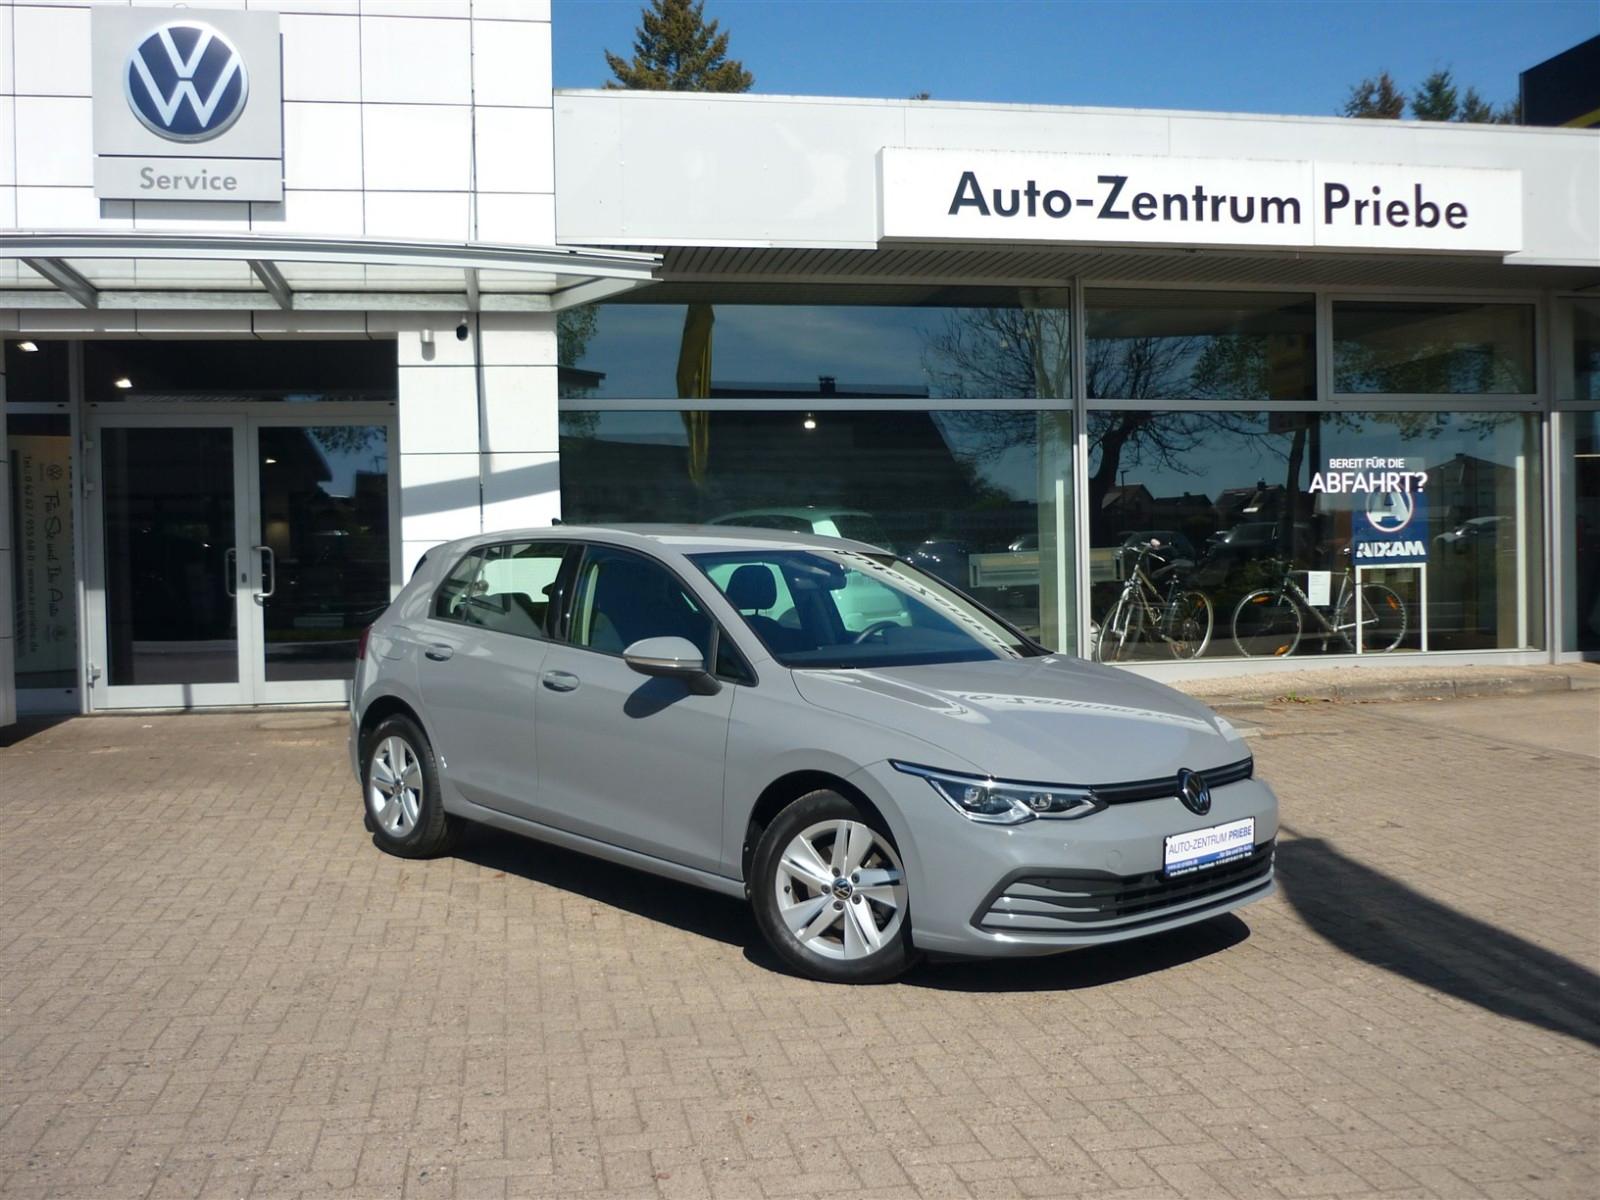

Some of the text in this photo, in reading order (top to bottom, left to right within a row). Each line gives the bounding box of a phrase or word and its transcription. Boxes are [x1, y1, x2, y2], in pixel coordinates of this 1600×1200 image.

[139, 166, 238, 191] Service
[947, 170, 1469, 230] Auto-Zentrum Priebe
[1329, 456, 1405, 469] BEREIT FÜR DIE
[1308, 471, 1428, 493] ABFAHRT?
[1356, 540, 1426, 558] AIXAM
[1168, 833, 1228, 855] AUTO-ZENTRUM
[1228, 825, 1252, 840] PRIEBE
